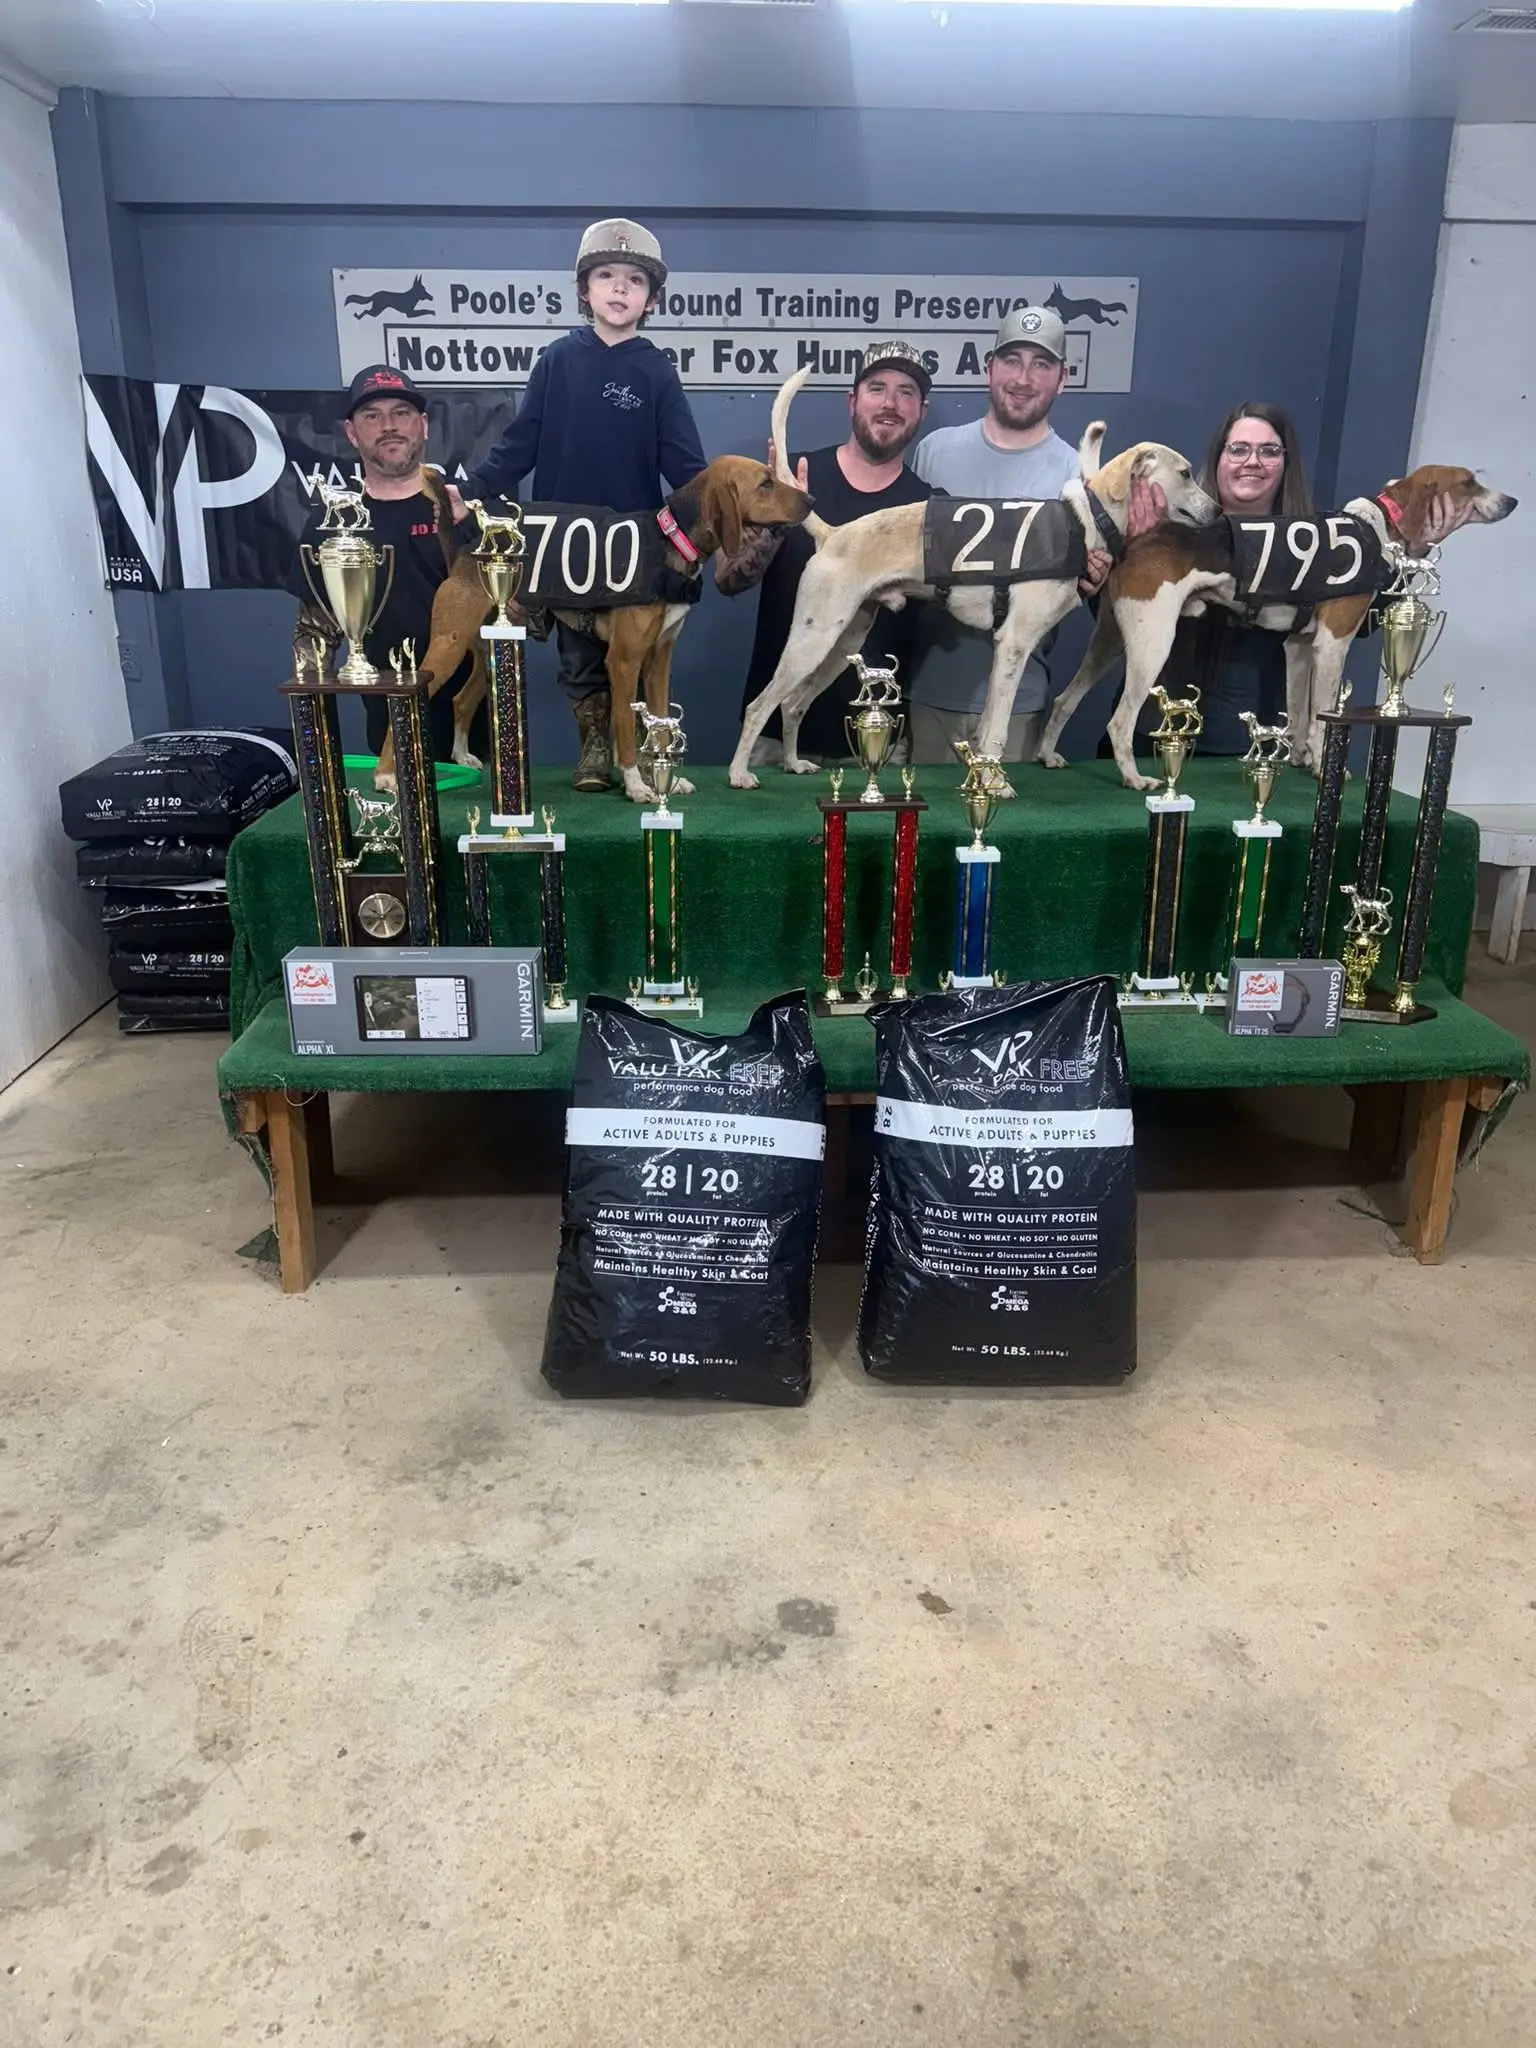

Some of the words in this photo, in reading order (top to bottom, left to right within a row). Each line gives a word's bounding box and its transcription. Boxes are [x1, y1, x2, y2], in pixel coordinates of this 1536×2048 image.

[450, 284, 562, 314] Poole's
[756, 287, 880, 323] Training
[713, 339, 778, 374] Fox
[797, 340, 939, 376] Huns
[951, 501, 1045, 573] 27
[523, 515, 640, 595] 700
[1240, 517, 1363, 594] 795
[111, 567, 143, 583] USA
[146, 797, 160, 807] 28
[168, 797, 182, 807] 20
[189, 954, 203, 963] 28
[211, 954, 225, 963] 20
[517, 962, 534, 1038] GARMIN
[1325, 971, 1342, 1028] GARMIN
[325, 1045, 336, 1055] XL
[970, 1031, 1033, 1073] VP
[608, 1056, 667, 1076] VALU
[993, 1058, 1033, 1086] PAK
[1040, 1058, 1091, 1080] FREE
[634, 1082, 700, 1093] performance
[703, 1083, 725, 1096] dog
[728, 1085, 753, 1096] food
[1020, 1082, 1037, 1094] dog
[1040, 1083, 1063, 1093] food
[644, 1116, 712, 1128] FORMULATED
[716, 1120, 736, 1129] FOR
[965, 1116, 1029, 1126] FORMULATED
[1033, 1117, 1053, 1125] FOR
[603, 1128, 649, 1140] ACTIVE
[655, 1130, 704, 1142] ADULTS
[709, 1133, 718, 1143] &
[724, 1134, 776, 1148] PUPPIES
[929, 1125, 972, 1139] ACTIVE
[977, 1129, 1023, 1141] ADULTS
[1044, 1129, 1097, 1141] PUPPIES
[641, 1164, 677, 1189] 28
[701, 1167, 739, 1193] 20
[968, 1164, 1005, 1189] 28
[1026, 1165, 1065, 1190] 20
[597, 1209, 630, 1220] MADE
[634, 1211, 663, 1223] WITH
[668, 1213, 720, 1226] QUALITY
[724, 1216, 768, 1229] PROTEIN
[924, 1206, 958, 1220] MADE
[962, 1211, 992, 1223] WITH
[997, 1213, 1048, 1224] QUALITY
[1051, 1212, 1098, 1223] PROTEIN
[595, 1228, 607, 1236] NO
[610, 1230, 633, 1239] CORN
[655, 1233, 681, 1242] WHEAT
[922, 1227, 935, 1235] NO
[938, 1230, 960, 1239] CORN
[968, 1233, 981, 1241] NO
[984, 1234, 1011, 1242] WHEAT
[1056, 1234, 1068, 1242] NO
[1070, 1233, 1098, 1242] GLUTEN
[922, 1244, 951, 1254] Natural
[986, 1250, 994, 1258] of
[594, 1259, 648, 1273] Maintains
[652, 1264, 698, 1279] Healthy
[702, 1269, 726, 1280] Skin
[730, 1270, 737, 1279] &
[742, 1269, 768, 1280] Coat
[922, 1258, 979, 1274] Maintains
[984, 1265, 1029, 1277] Healthy
[1033, 1265, 1057, 1276] Skin
[1061, 1266, 1068, 1274] &
[1072, 1264, 1097, 1274] Coat
[649, 1351, 668, 1362] 50
[672, 1352, 700, 1365] LBS.
[981, 1344, 999, 1354] 50
[1003, 1345, 1031, 1356] LBS.
